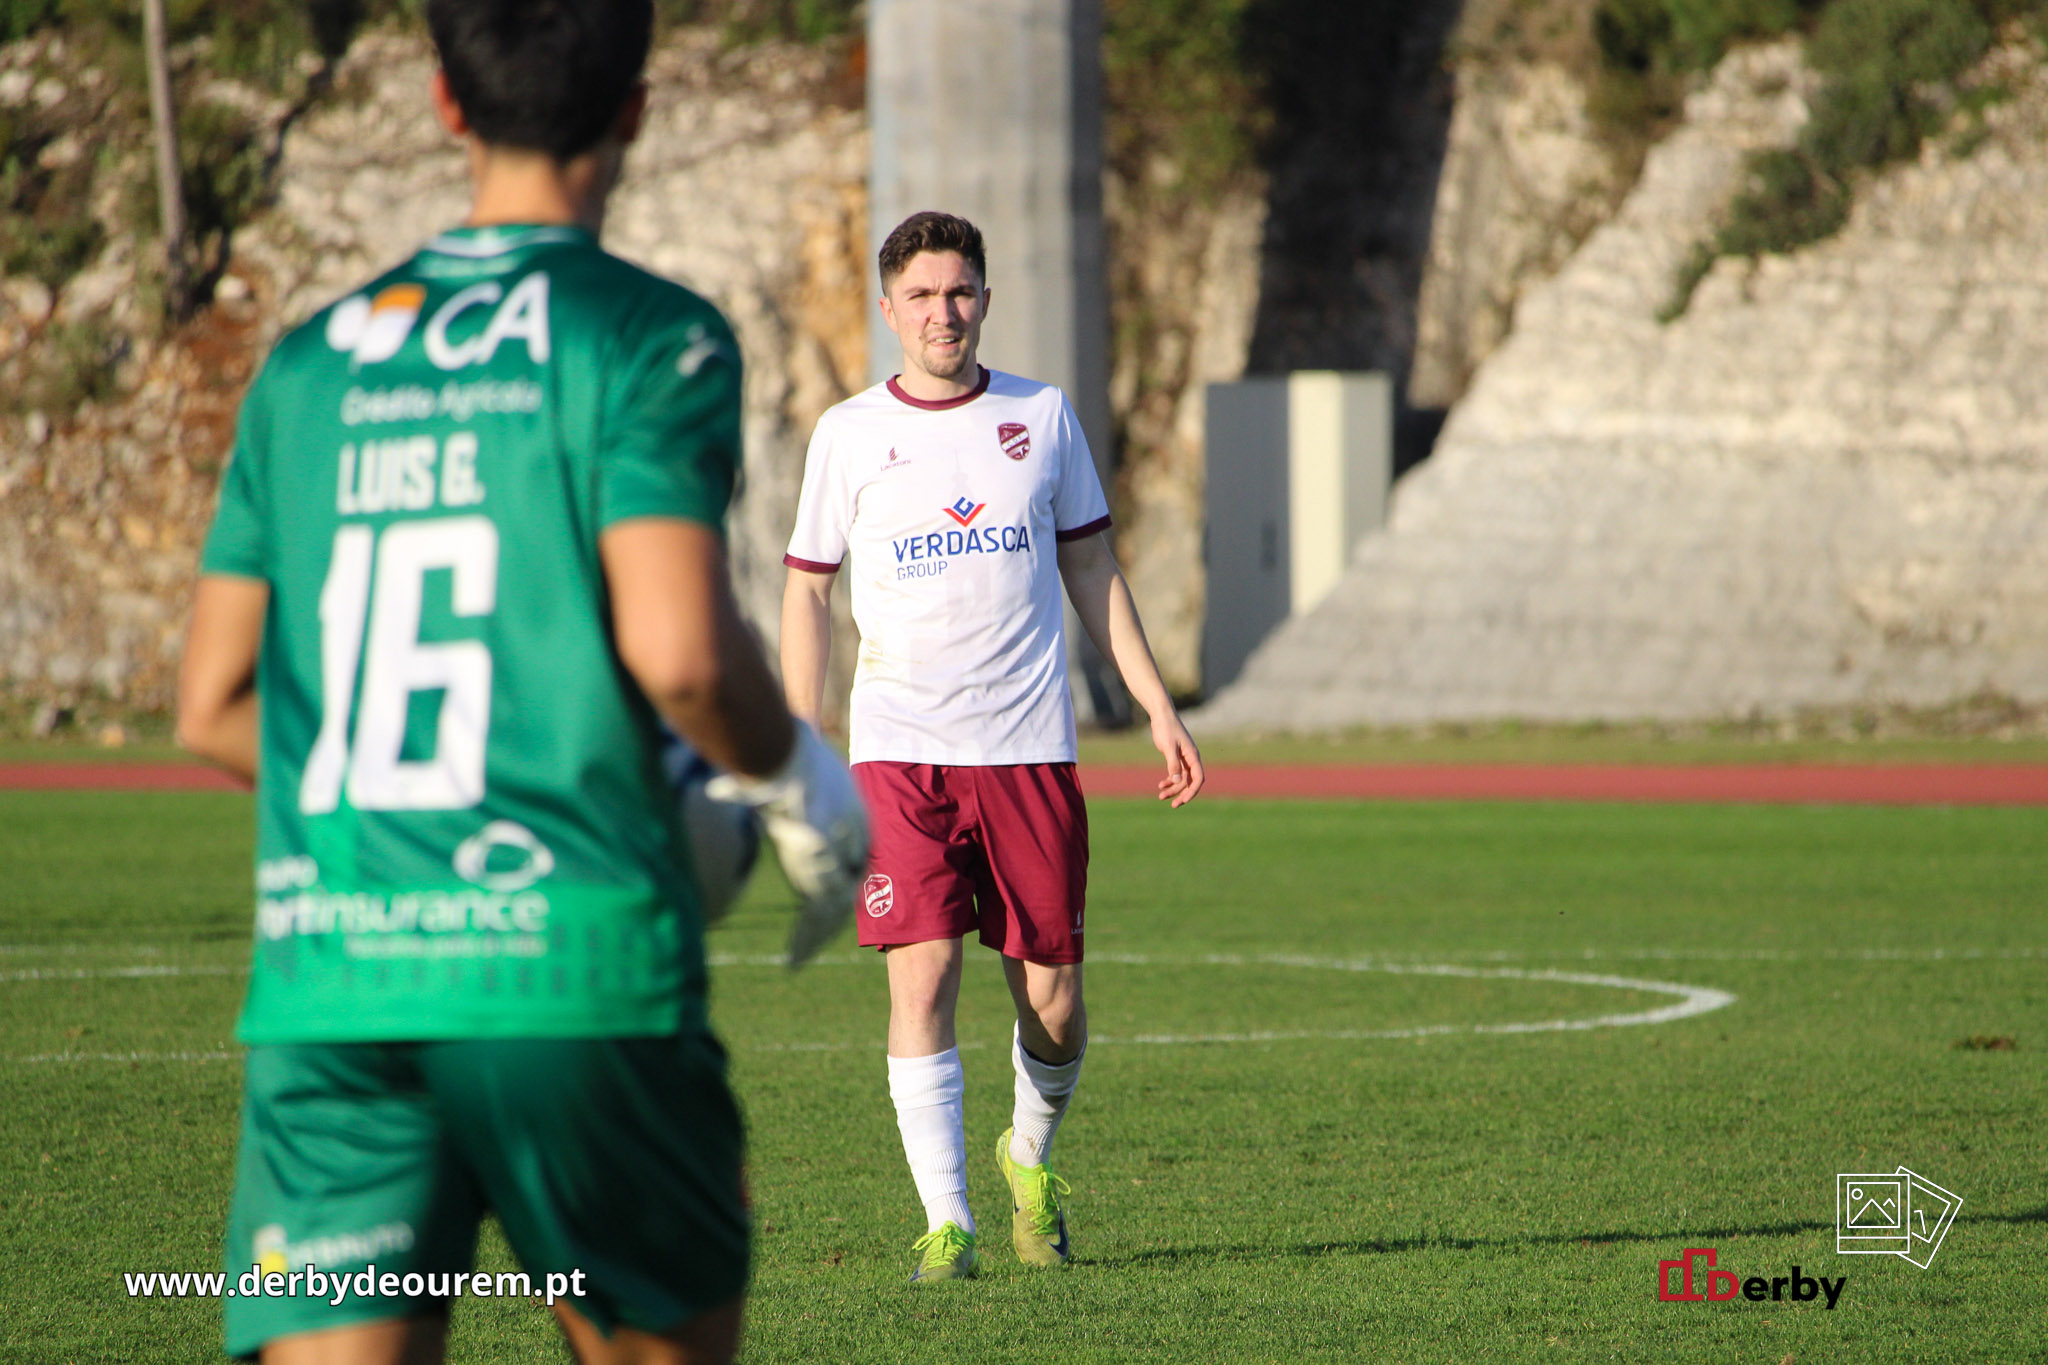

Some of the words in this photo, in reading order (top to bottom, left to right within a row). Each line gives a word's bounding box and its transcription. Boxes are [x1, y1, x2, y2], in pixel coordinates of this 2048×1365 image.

[424, 270, 551, 371] CA
[337, 438, 436, 514] LUIS
[440, 431, 486, 506] G.
[893, 526, 1030, 563] VERDASCA
[896, 560, 949, 581] GROUP
[300, 515, 500, 816] 16
